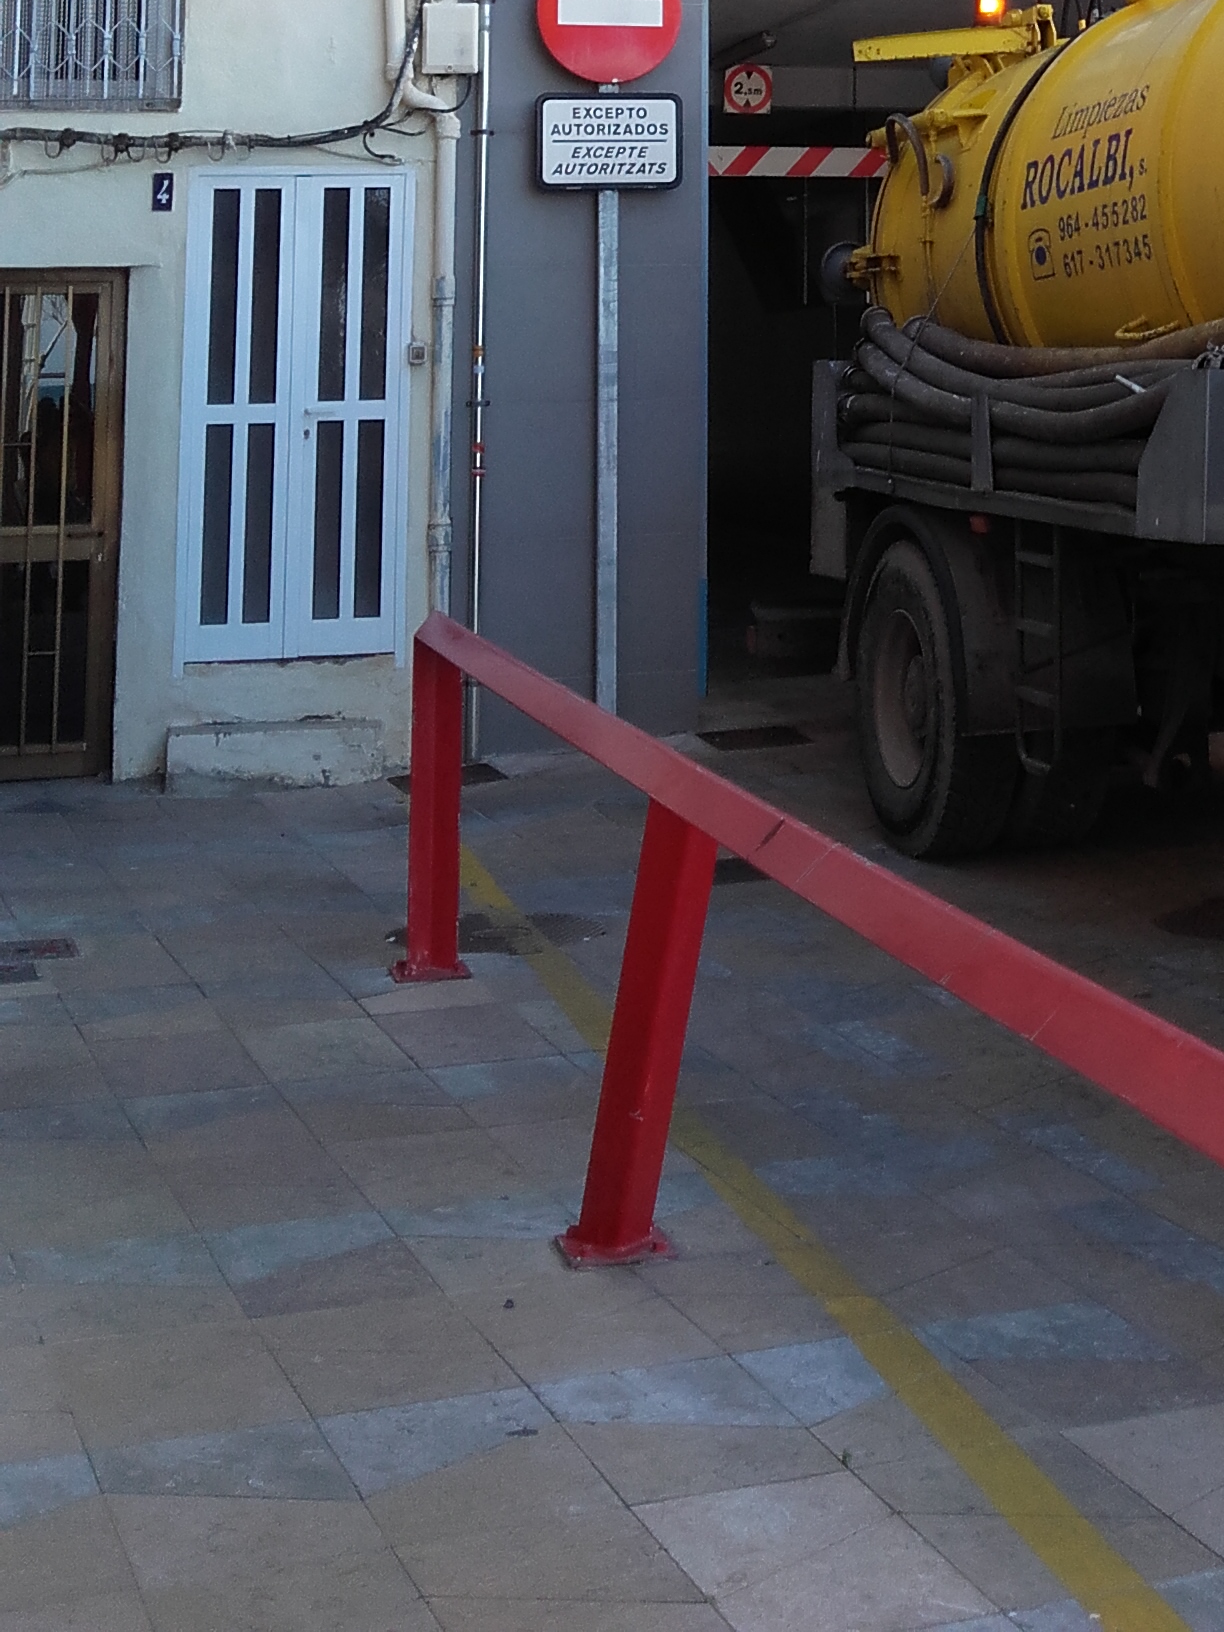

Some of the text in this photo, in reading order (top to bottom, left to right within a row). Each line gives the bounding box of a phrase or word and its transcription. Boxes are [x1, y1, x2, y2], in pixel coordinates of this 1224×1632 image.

[572, 107, 648, 119] EXCEPTO
[1052, 83, 1150, 141] Limpiezas
[550, 123, 669, 136] AUTORIZADOS
[571, 146, 649, 159] EXCEPTE
[551, 162, 668, 175] AUTORITZATS
[156, 179, 170, 204] 4
